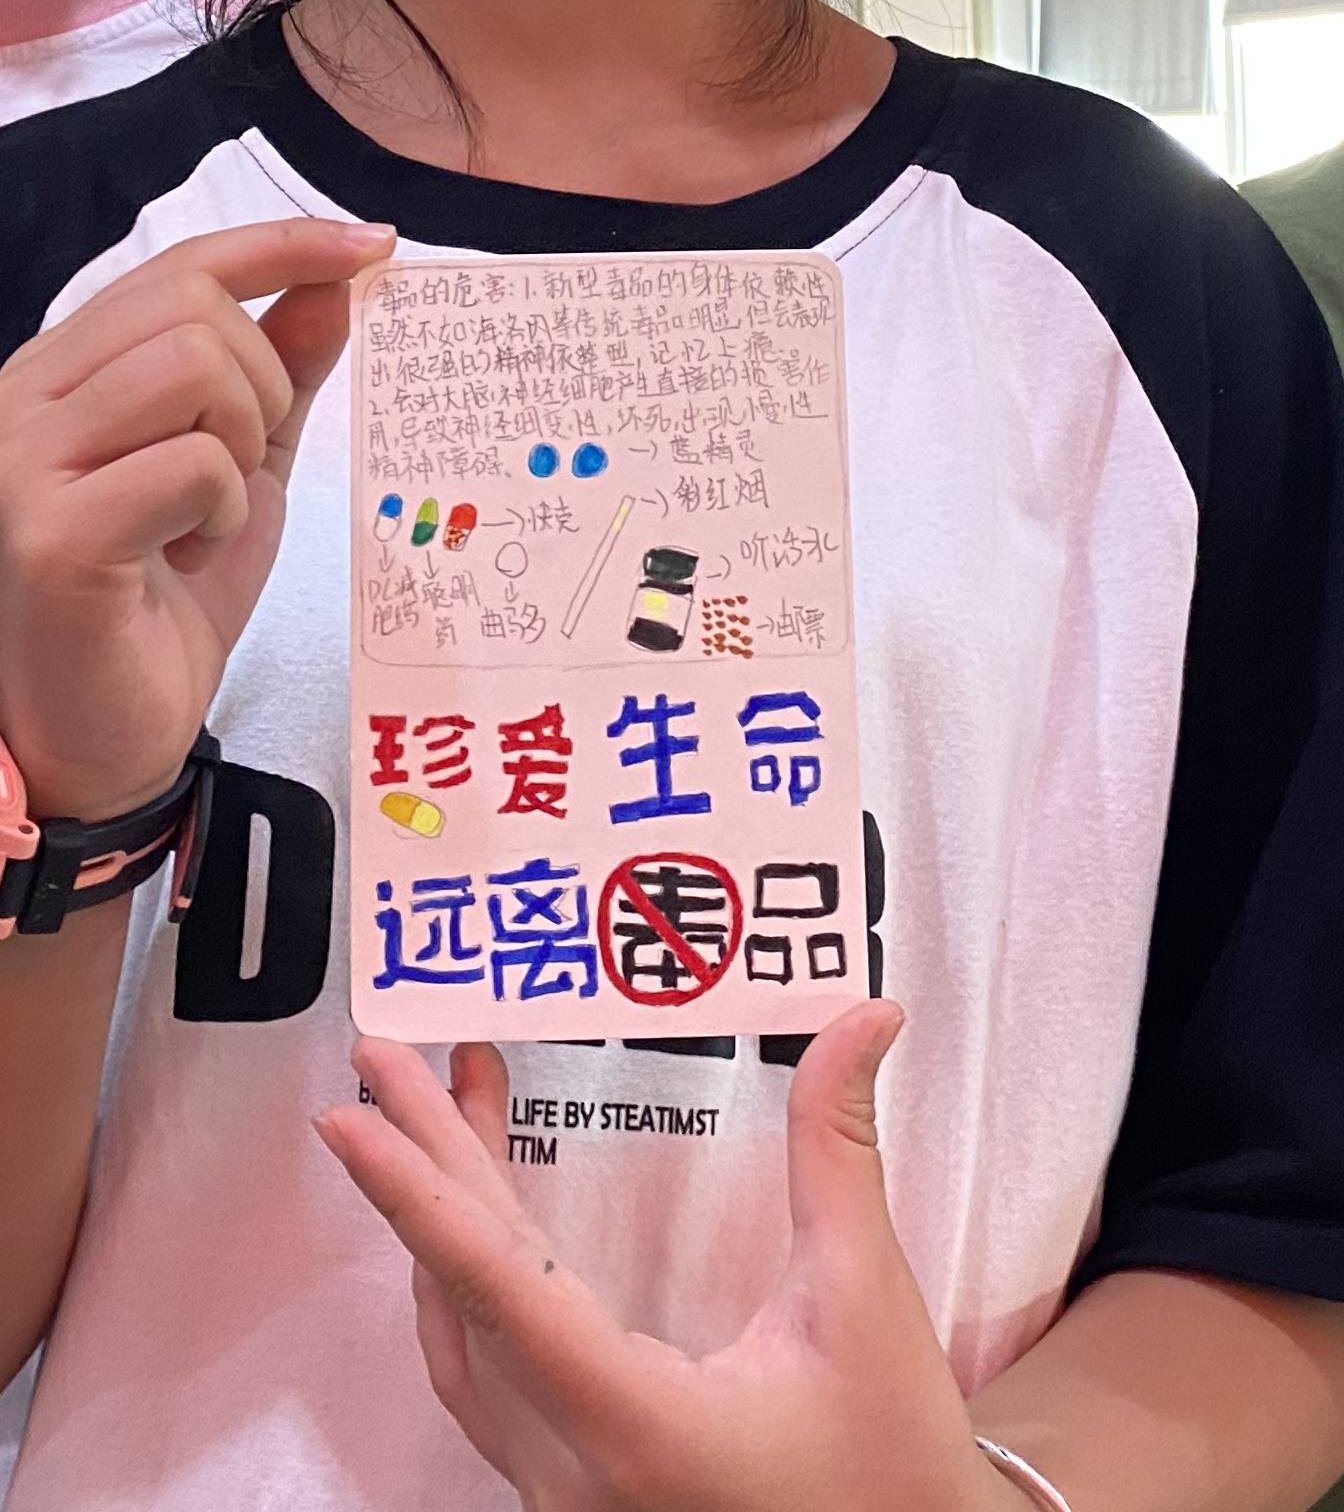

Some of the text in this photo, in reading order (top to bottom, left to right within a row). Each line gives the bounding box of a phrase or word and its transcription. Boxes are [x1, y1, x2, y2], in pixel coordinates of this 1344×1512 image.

[481, 603, 546, 644] 曲马多
[368, 690, 825, 824] 珍爱生命
[373, 856, 848, 1003] 远离毒品
[513, 1096, 719, 1137] LIFE BY STEATIMST
